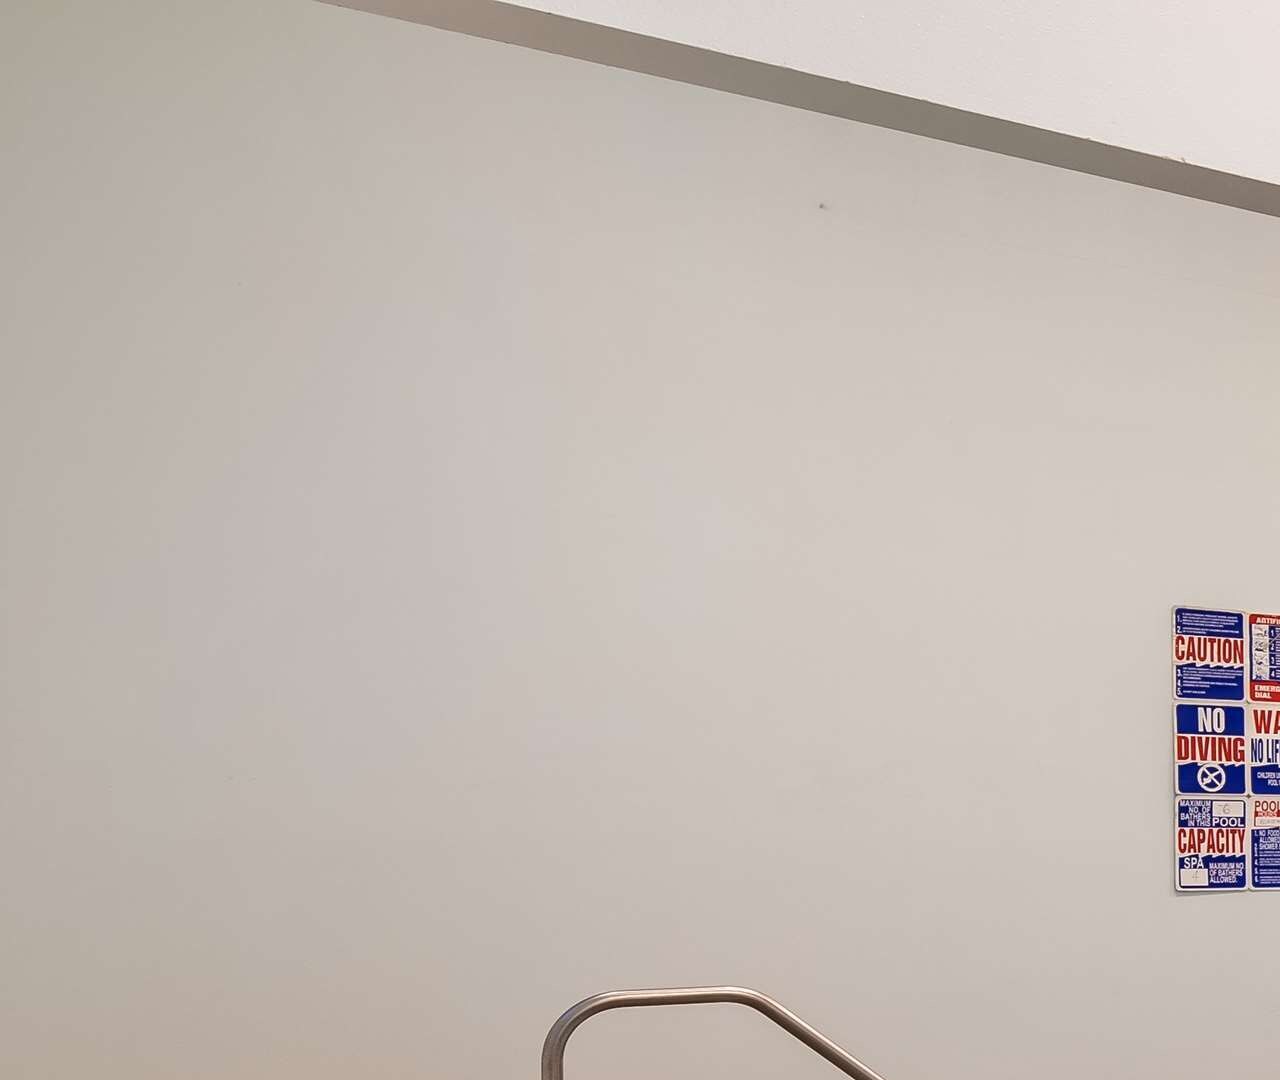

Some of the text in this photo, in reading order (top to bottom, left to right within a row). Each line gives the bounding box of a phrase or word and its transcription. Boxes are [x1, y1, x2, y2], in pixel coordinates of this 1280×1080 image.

[1175, 635, 1244, 664] CAUTION
[1255, 691, 1272, 699] DIAL
[1197, 707, 1226, 734] NO
[1176, 735, 1246, 763] DIVING
[1251, 738, 1264, 763] NO
[1255, 801, 1280, 812] POOL
[1212, 817, 1245, 827] POOL
[1178, 828, 1246, 854] CAPACITY
[1184, 857, 1204, 869] SPA
